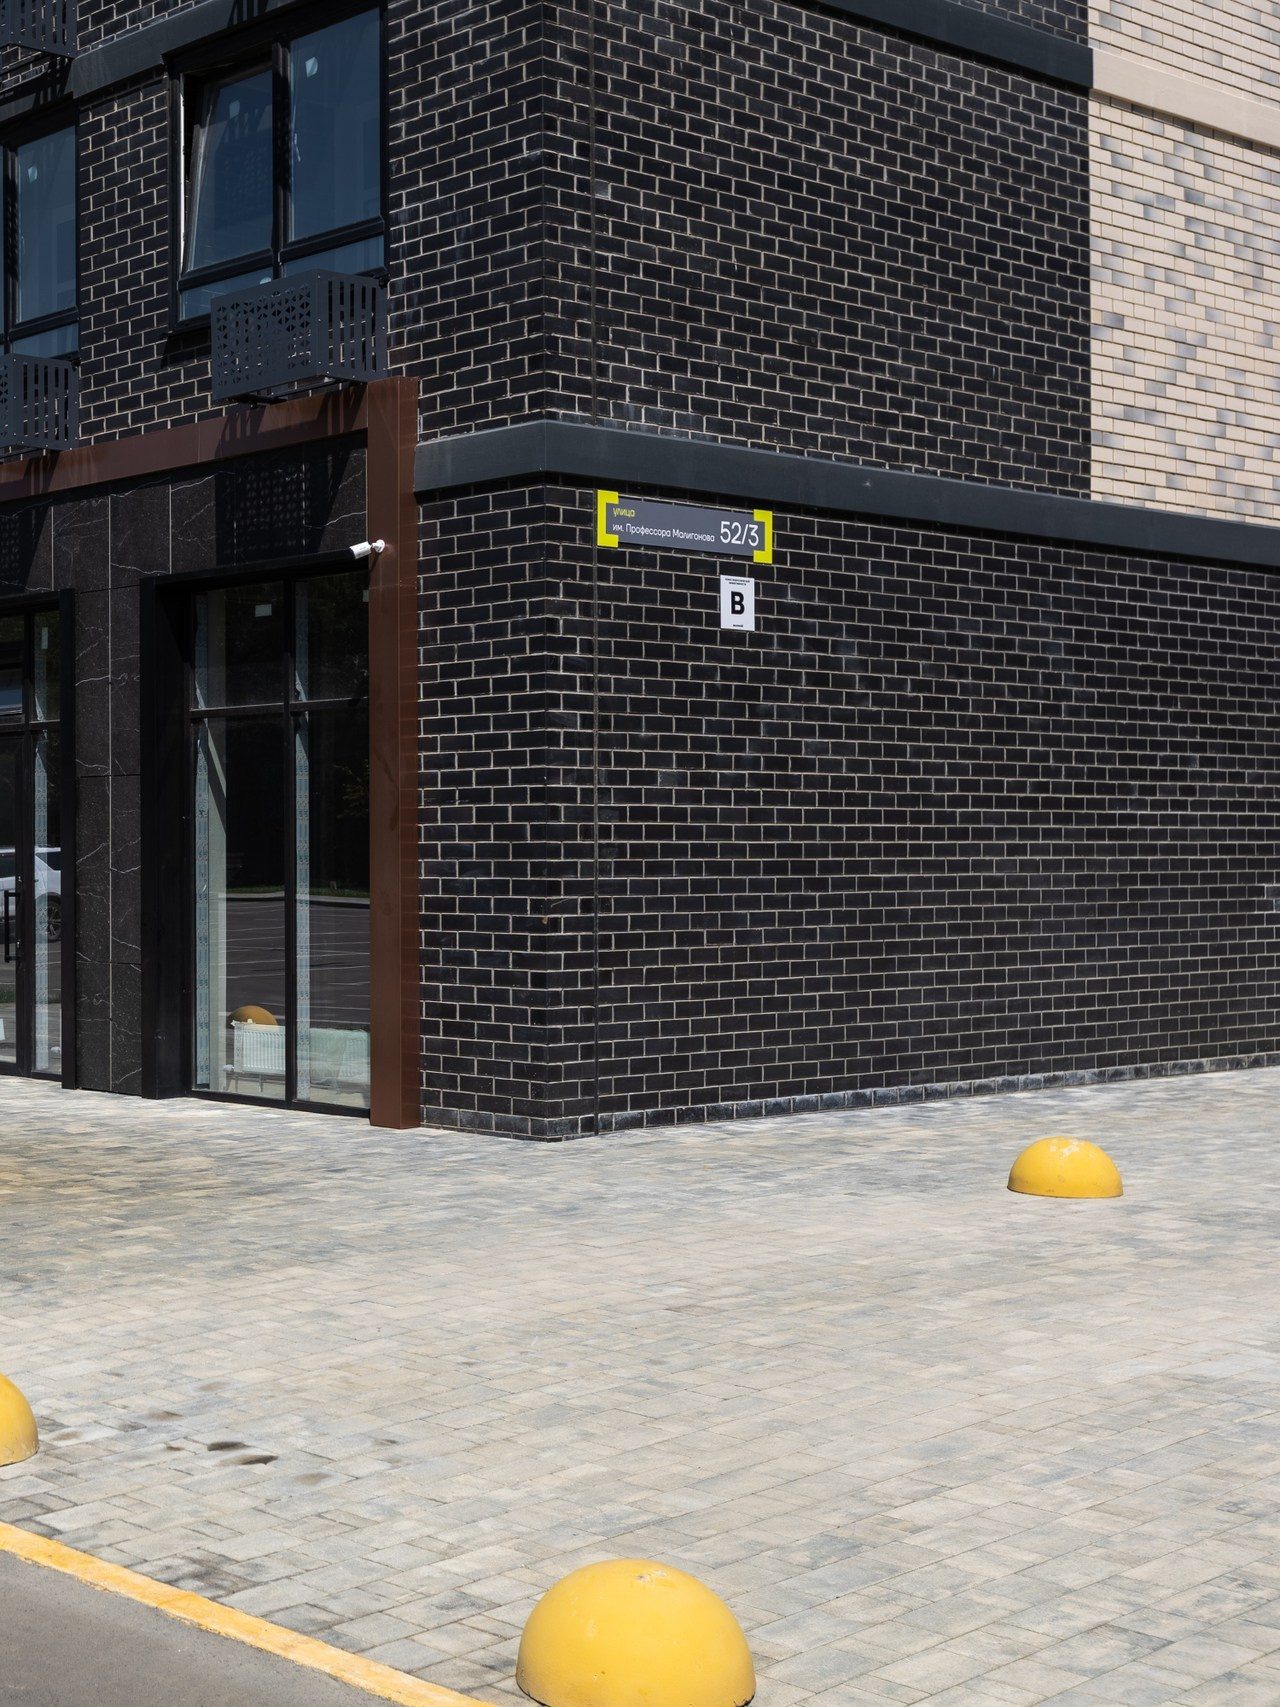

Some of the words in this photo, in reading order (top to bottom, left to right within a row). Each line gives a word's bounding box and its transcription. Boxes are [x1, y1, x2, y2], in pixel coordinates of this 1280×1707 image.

[613, 507, 636, 518] улица
[612, 523, 624, 532] им.
[625, 523, 671, 538] Профессора
[672, 529, 715, 542] Малигонова
[720, 521, 759, 546] 52/3
